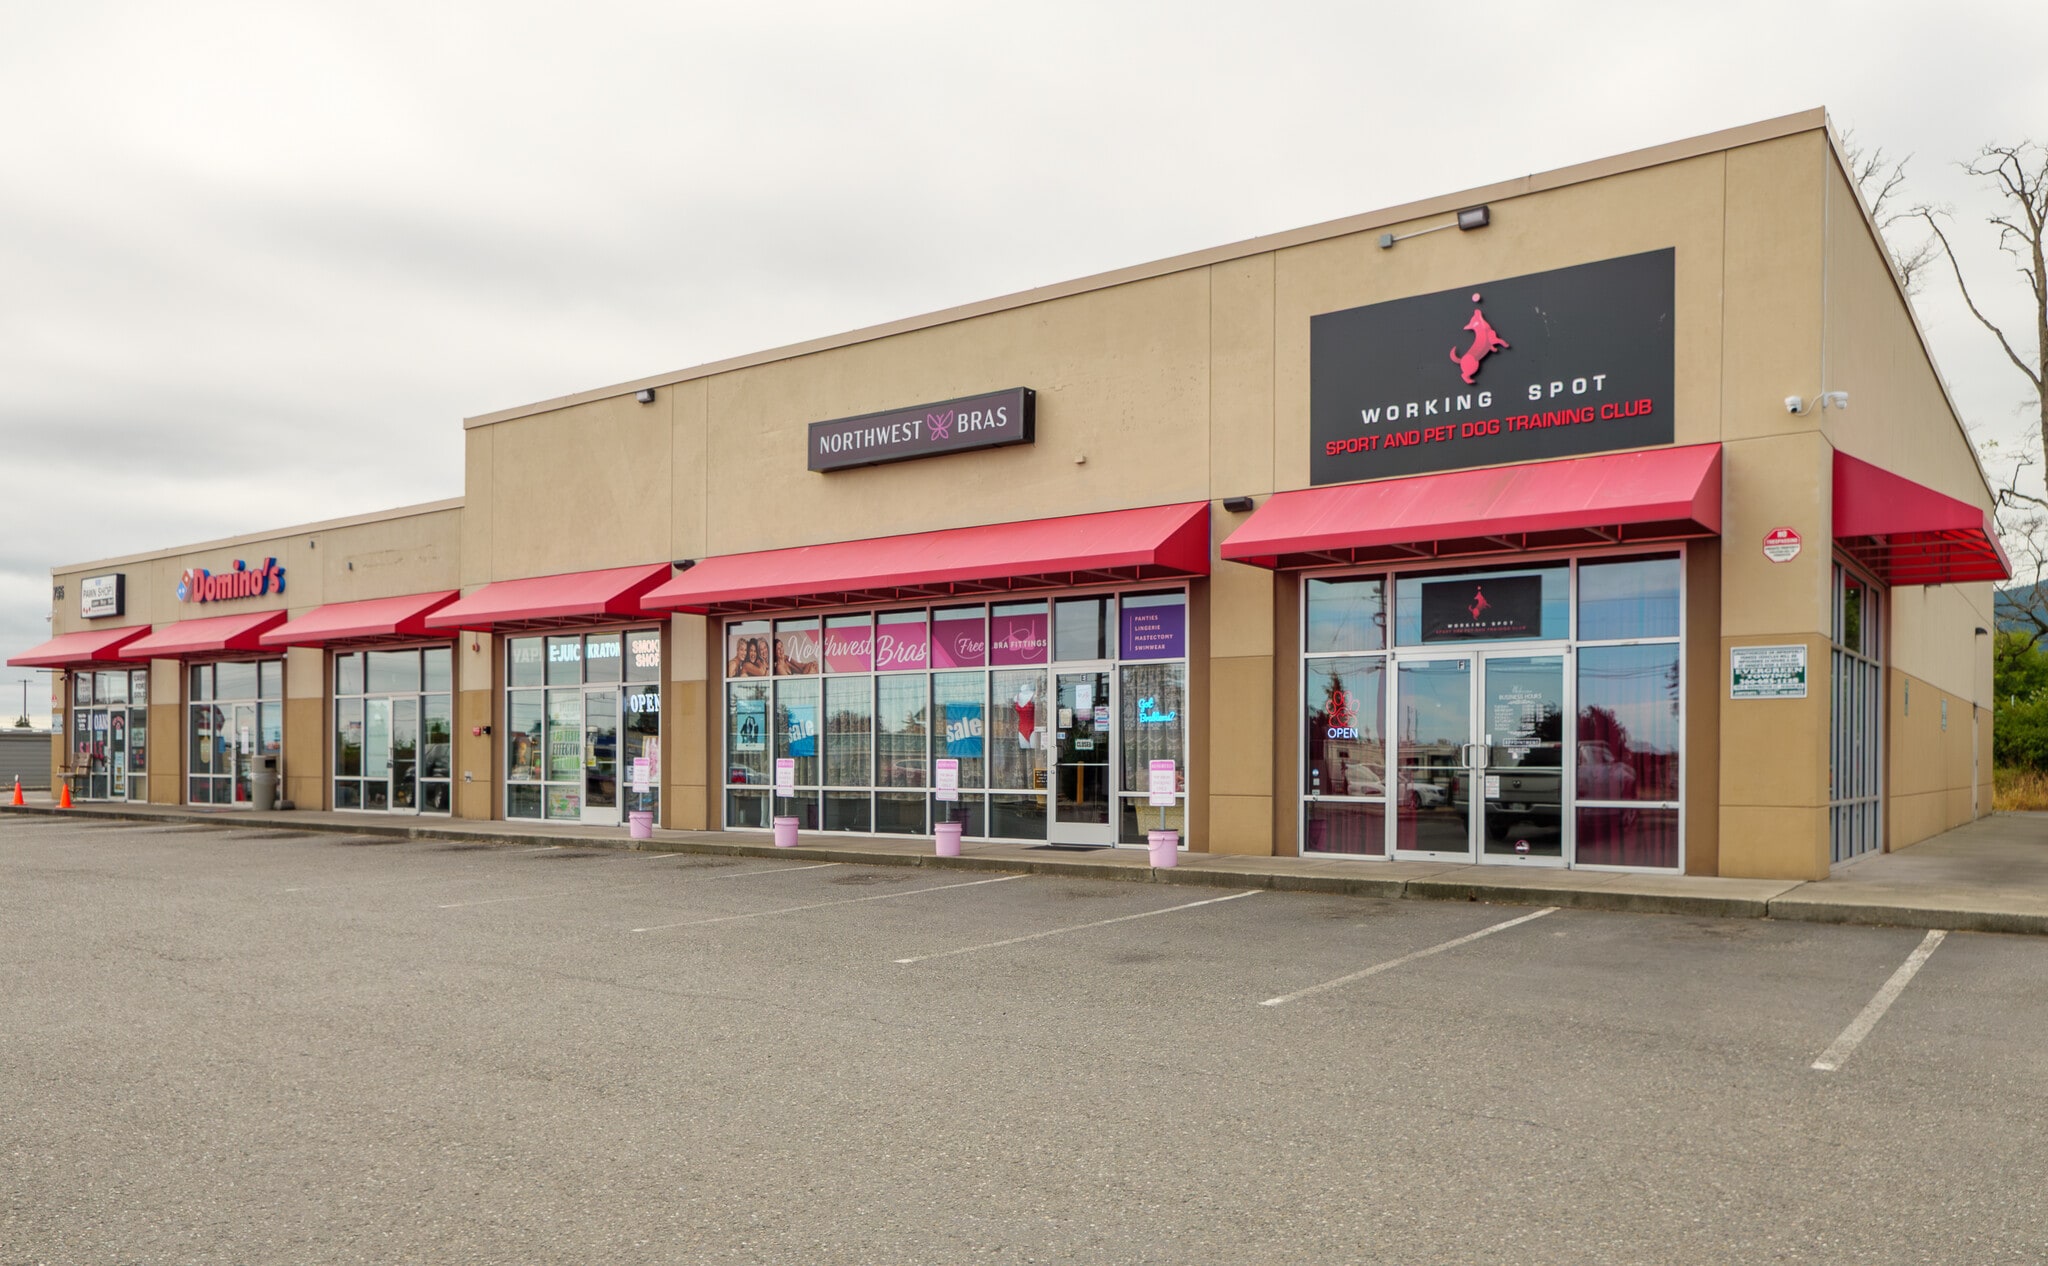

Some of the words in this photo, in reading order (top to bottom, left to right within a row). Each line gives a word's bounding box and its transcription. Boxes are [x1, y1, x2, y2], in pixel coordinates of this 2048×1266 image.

[1361, 391, 1493, 424] WORKING
[1528, 374, 1607, 401] SPOT
[819, 420, 923, 455] NORTHWEST
[957, 406, 1008, 434] BRAS
[1325, 435, 1381, 456] SPORT
[1383, 430, 1421, 450] AND
[1423, 425, 1457, 444] PET
[1461, 419, 1501, 439] DOG
[1505, 406, 1595, 432] TRAINING
[1600, 398, 1653, 421] CLUB
[192, 557, 286, 603] Domino's
[549, 643, 581, 662] E-JUIC
[632, 640, 660, 654] SMOK
[787, 634, 874, 663] Northwest
[876, 634, 928, 667] Bras
[958, 637, 985, 655] Free
[993, 641, 1009, 649] BRA
[1010, 639, 1048, 648] FITTINGS
[946, 716, 983, 743] sale
[1327, 727, 1359, 739] OPEN
[552, 742, 581, 756] EFFECTIV
